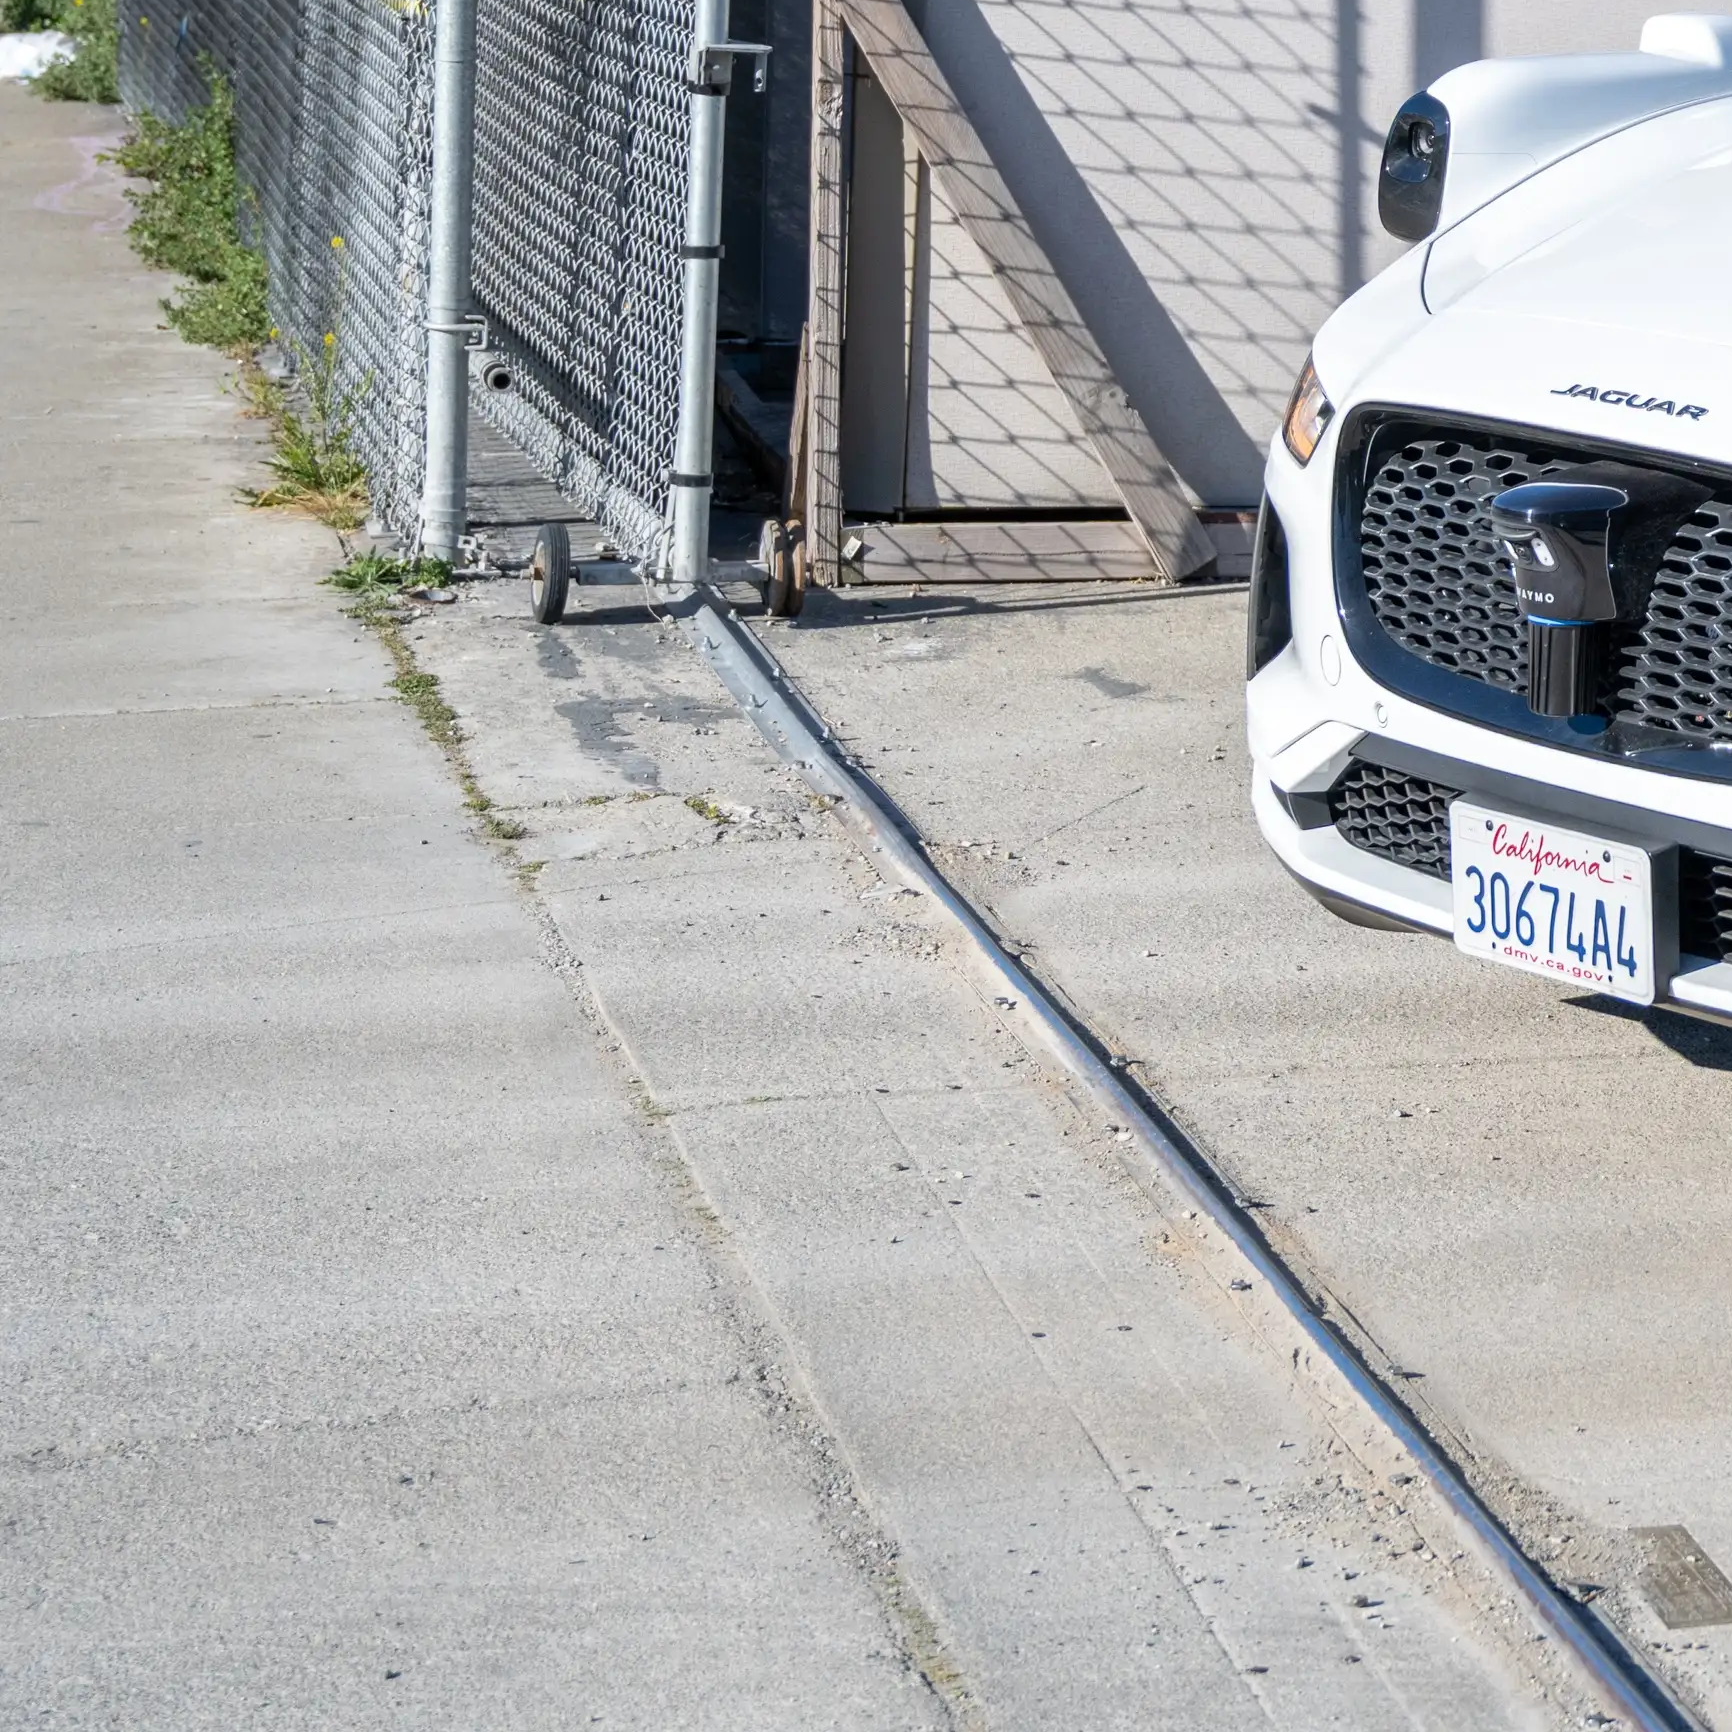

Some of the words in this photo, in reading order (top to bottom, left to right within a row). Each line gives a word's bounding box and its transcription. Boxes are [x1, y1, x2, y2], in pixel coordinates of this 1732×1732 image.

[1549, 383, 1710, 422] JAGUAR
[1492, 823, 1615, 884] California
[1465, 864, 1638, 978] 30674A4
[1503, 944, 1605, 982] dmv.ca.gov
